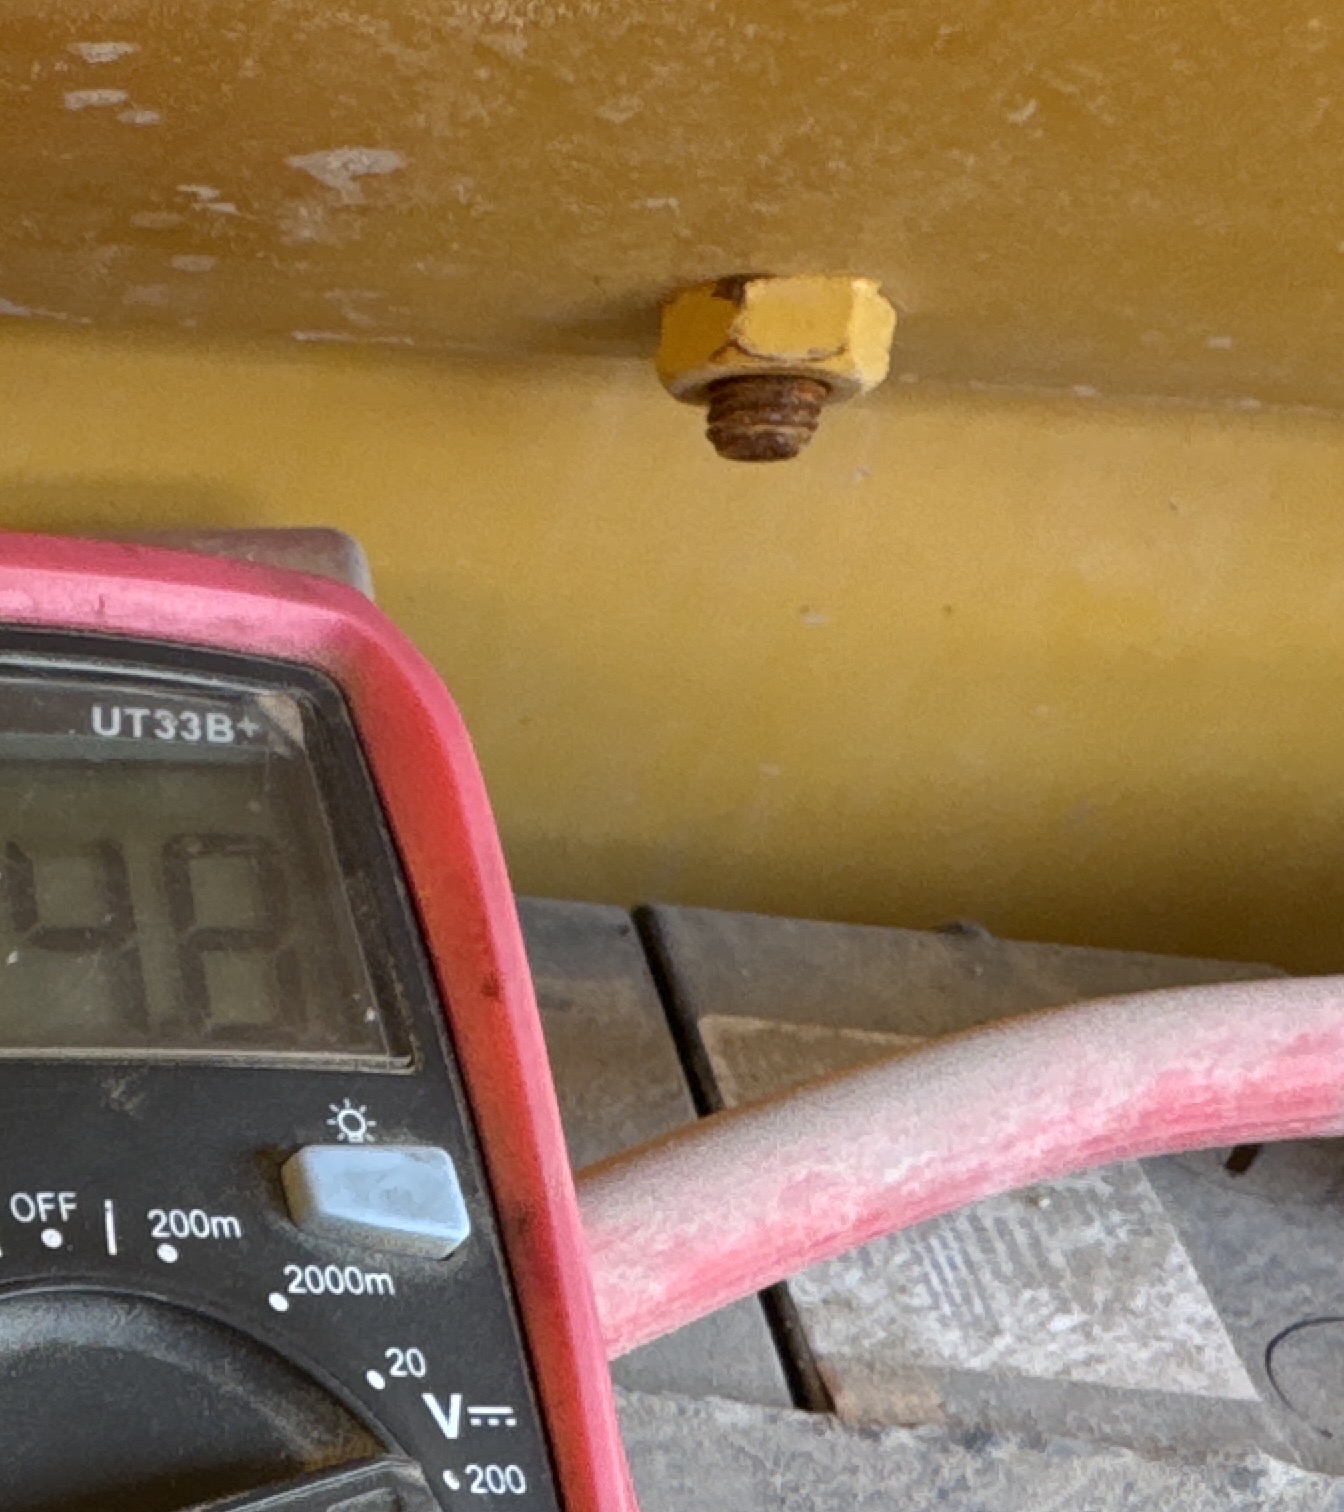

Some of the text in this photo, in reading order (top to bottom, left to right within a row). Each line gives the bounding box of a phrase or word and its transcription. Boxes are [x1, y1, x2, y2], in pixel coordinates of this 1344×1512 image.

[92, 704, 261, 745] UT33B+
[10, 1191, 78, 1223] OFF
[147, 1208, 242, 1239] 200m
[283, 1264, 396, 1297] 2000m
[384, 1346, 427, 1378] 20
[465, 1463, 528, 1495] 200
